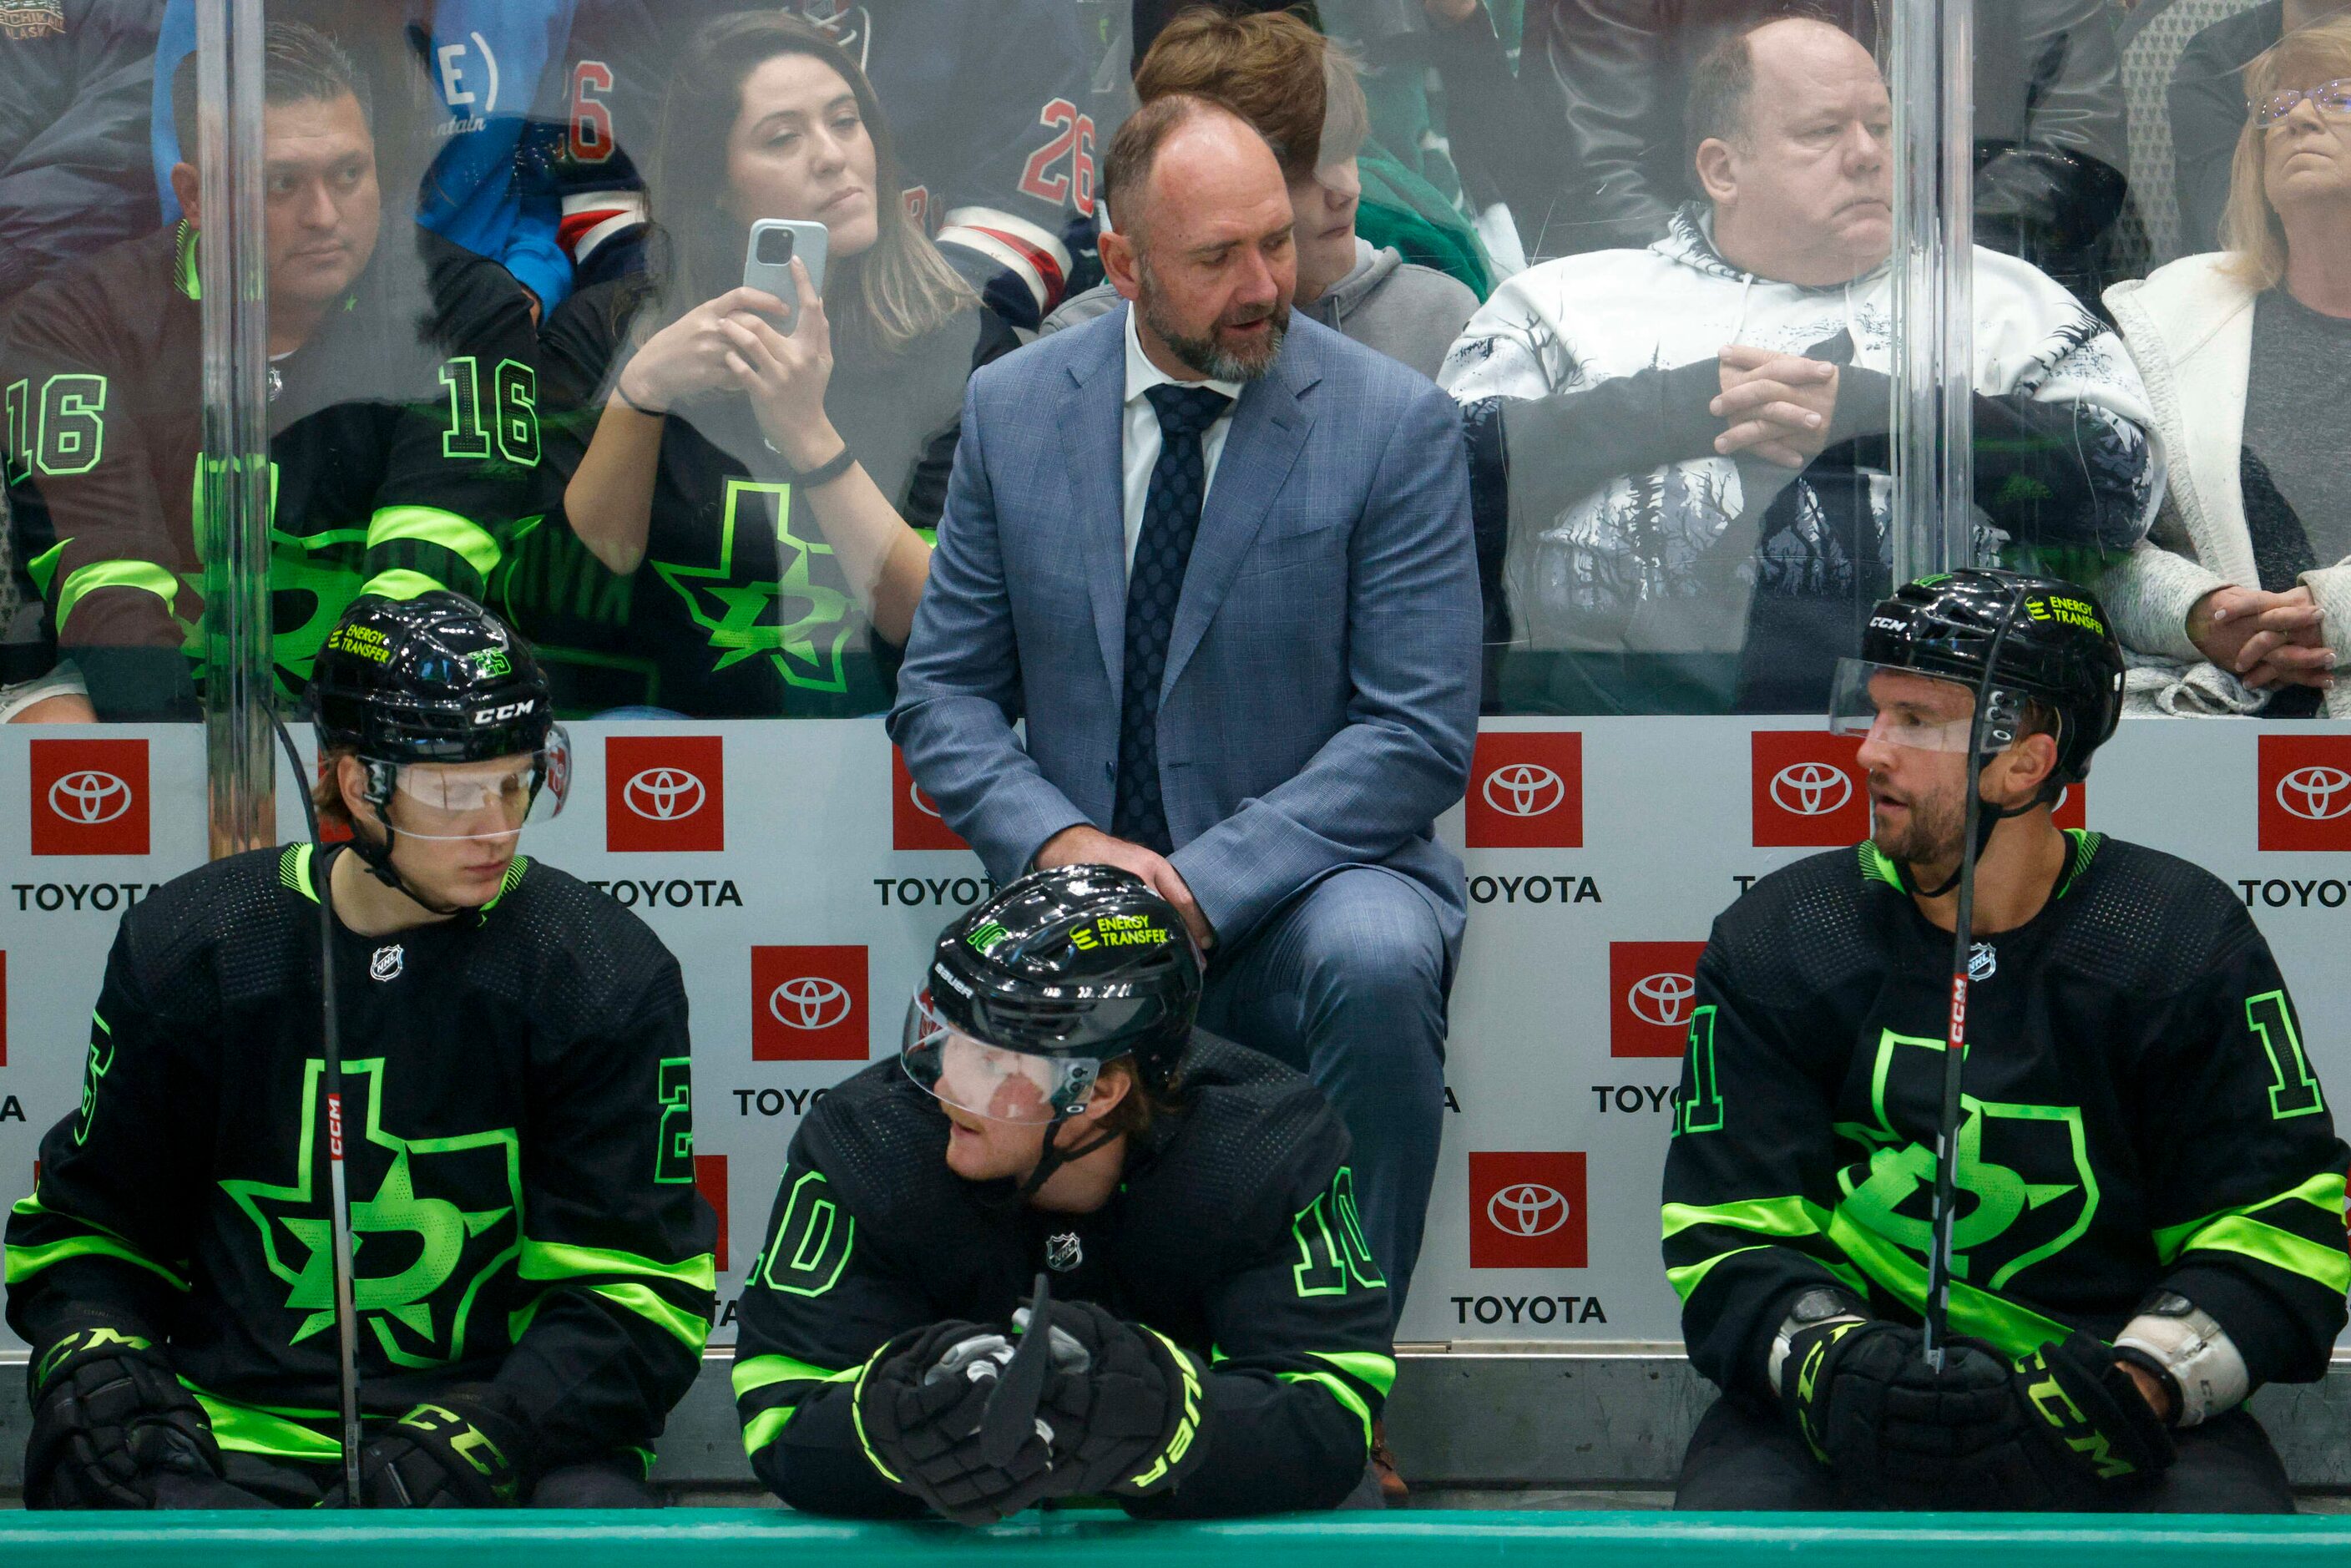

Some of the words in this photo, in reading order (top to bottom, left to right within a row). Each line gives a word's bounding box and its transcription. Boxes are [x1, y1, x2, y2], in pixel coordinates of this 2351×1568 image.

[434, 114, 487, 136] ntain
[558, 60, 615, 163] 6
[1016, 97, 1095, 218] 26
[438, 356, 541, 467] 16
[6, 373, 108, 487] 16
[2050, 595, 2093, 616] ENERGY
[346, 624, 386, 645] ENERGY
[1869, 616, 1908, 632] CCM
[341, 637, 390, 664] TRANSFER
[467, 646, 512, 679] 25
[473, 699, 534, 725] CCM
[873, 878, 995, 906] TOYOT
[1464, 876, 1602, 903] OYOTA
[2237, 879, 2351, 908] TOYO
[1097, 915, 1150, 933] ENERGY
[1100, 928, 1169, 946] TRANSFER
[1951, 978, 1968, 1043] CCM
[1671, 1004, 1724, 1138] 1
[328, 1098, 342, 1156] CCM
[1292, 1166, 1387, 1297] 10
[1451, 1296, 1607, 1324] TOYOTA
[35, 1327, 154, 1390] CM
[2015, 1350, 2136, 1479] CCM
